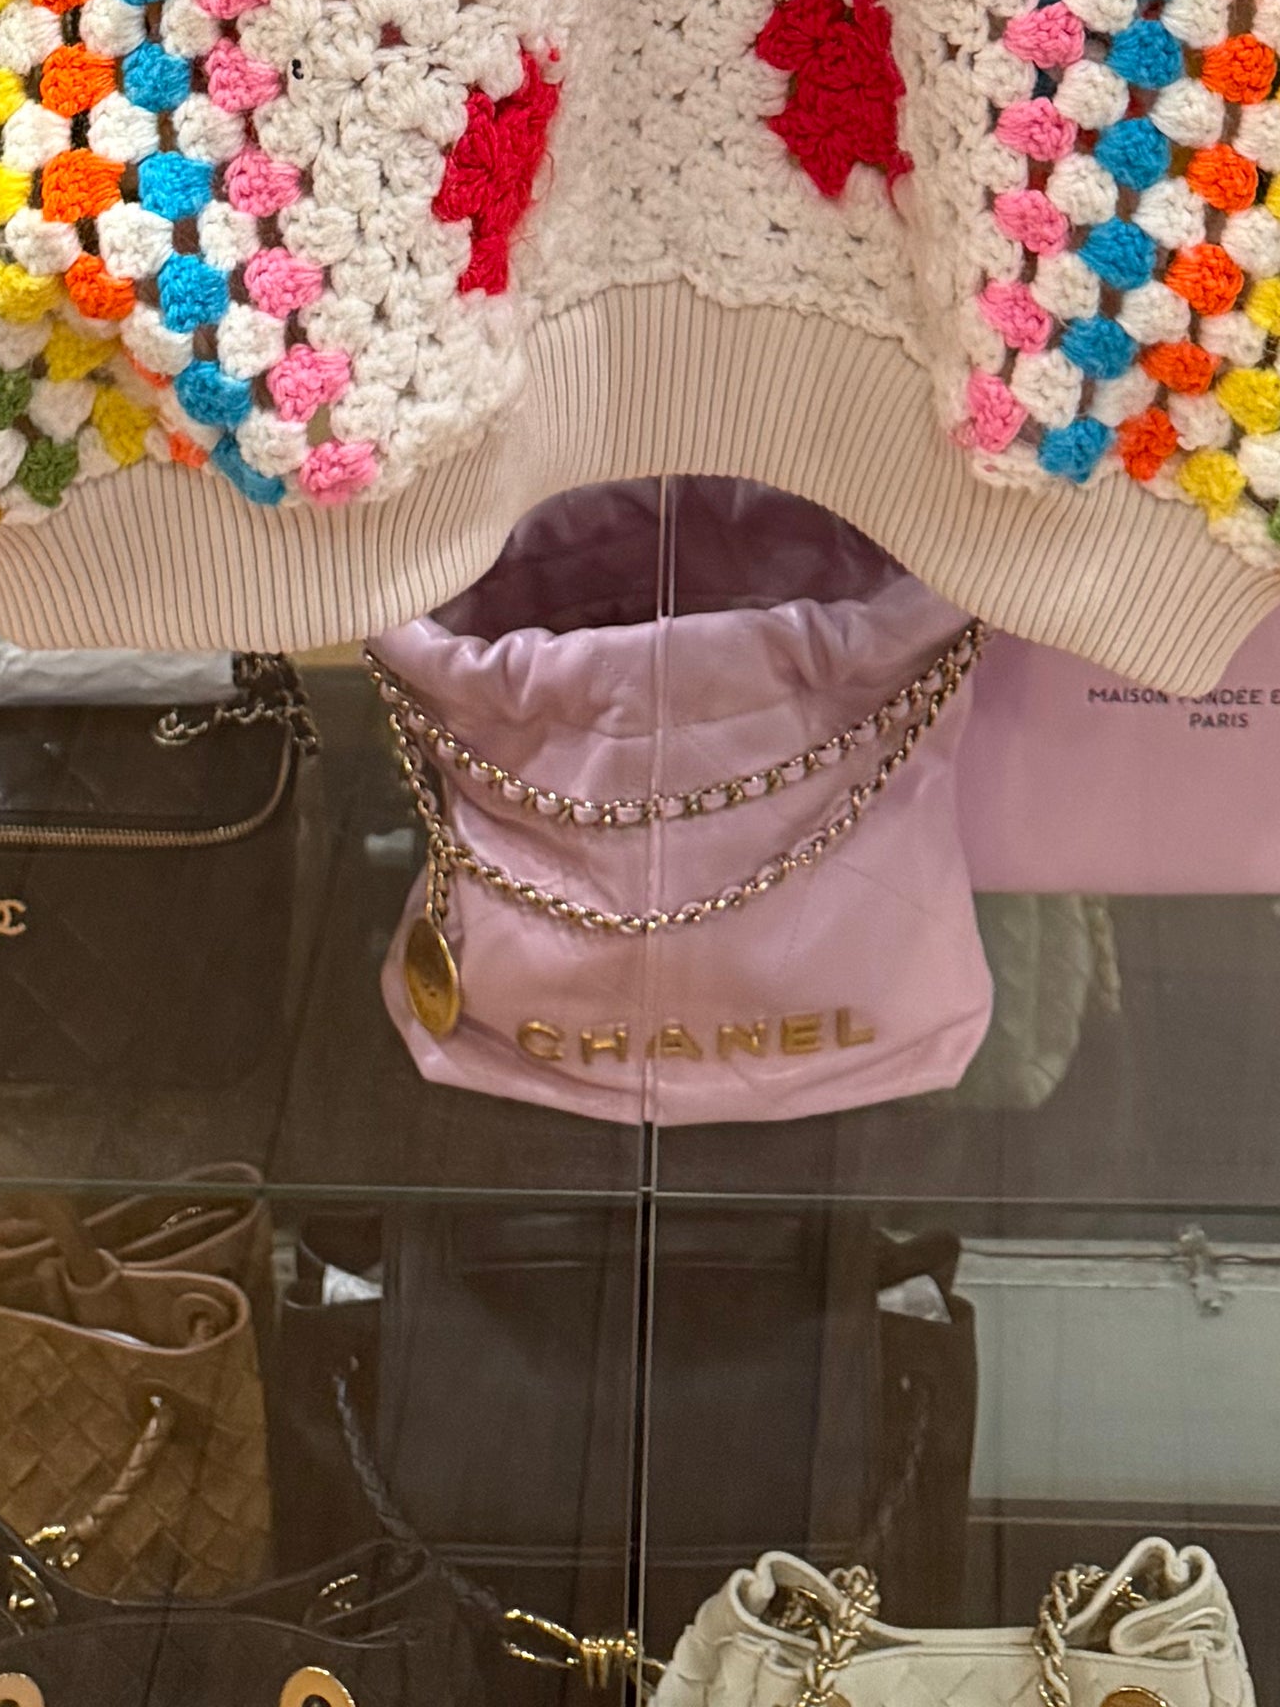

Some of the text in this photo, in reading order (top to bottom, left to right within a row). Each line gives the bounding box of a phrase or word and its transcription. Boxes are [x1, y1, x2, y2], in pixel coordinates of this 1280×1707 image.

[1087, 688, 1169, 704] MAISON
[1188, 712, 1250, 729] PARIS
[516, 1007, 876, 1066] CHANEL
